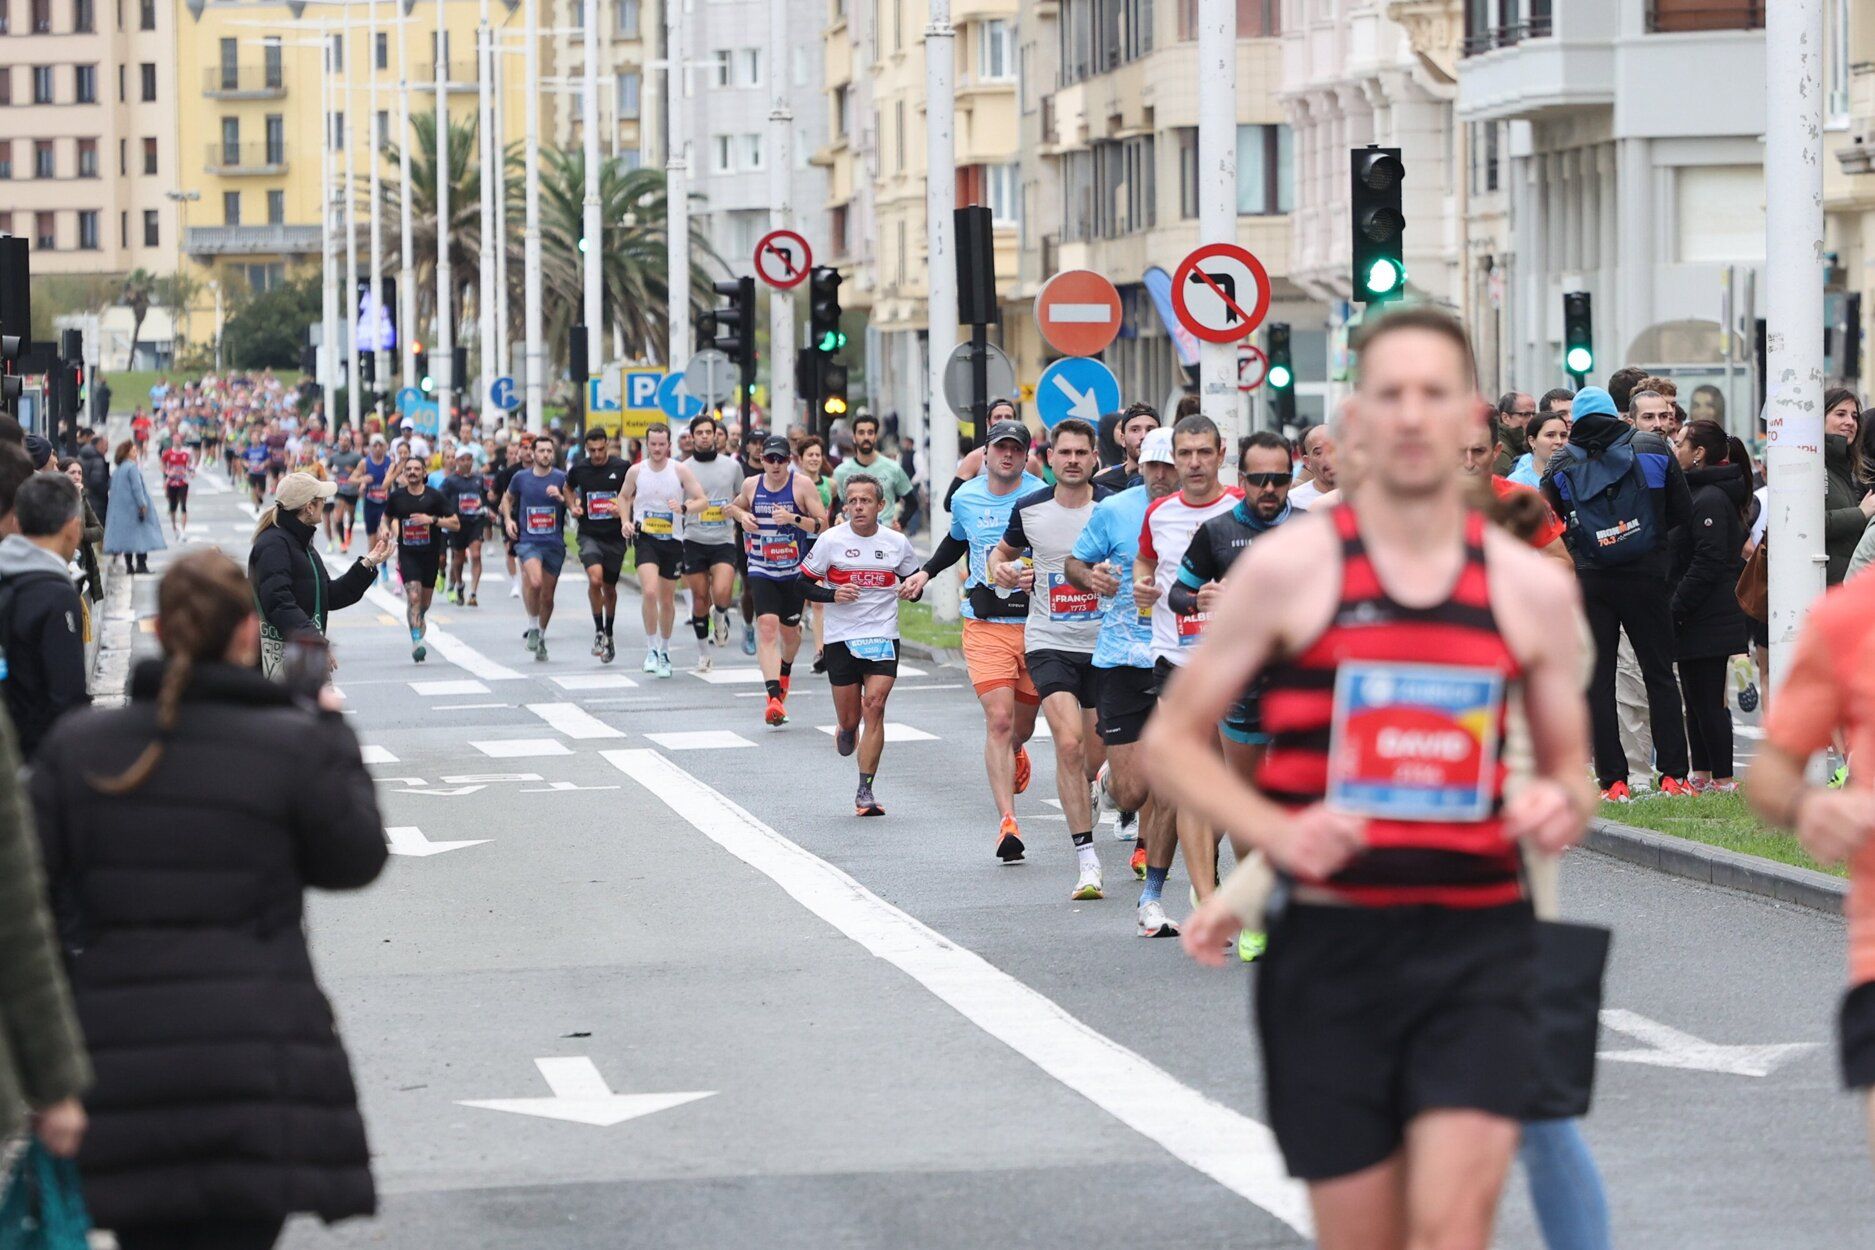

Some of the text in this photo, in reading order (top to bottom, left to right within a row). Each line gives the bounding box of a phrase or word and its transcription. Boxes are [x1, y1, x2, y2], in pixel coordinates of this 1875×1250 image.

[633, 376, 656, 406] P
[1595, 518, 1641, 540] IRONMAN
[1597, 535, 1617, 548] 70.3
[850, 574, 886, 582] ELCHE
[1055, 592, 1100, 604] FRANÇOIS
[1070, 604, 1087, 612] 1773
[1183, 611, 1217, 623] ALBE
